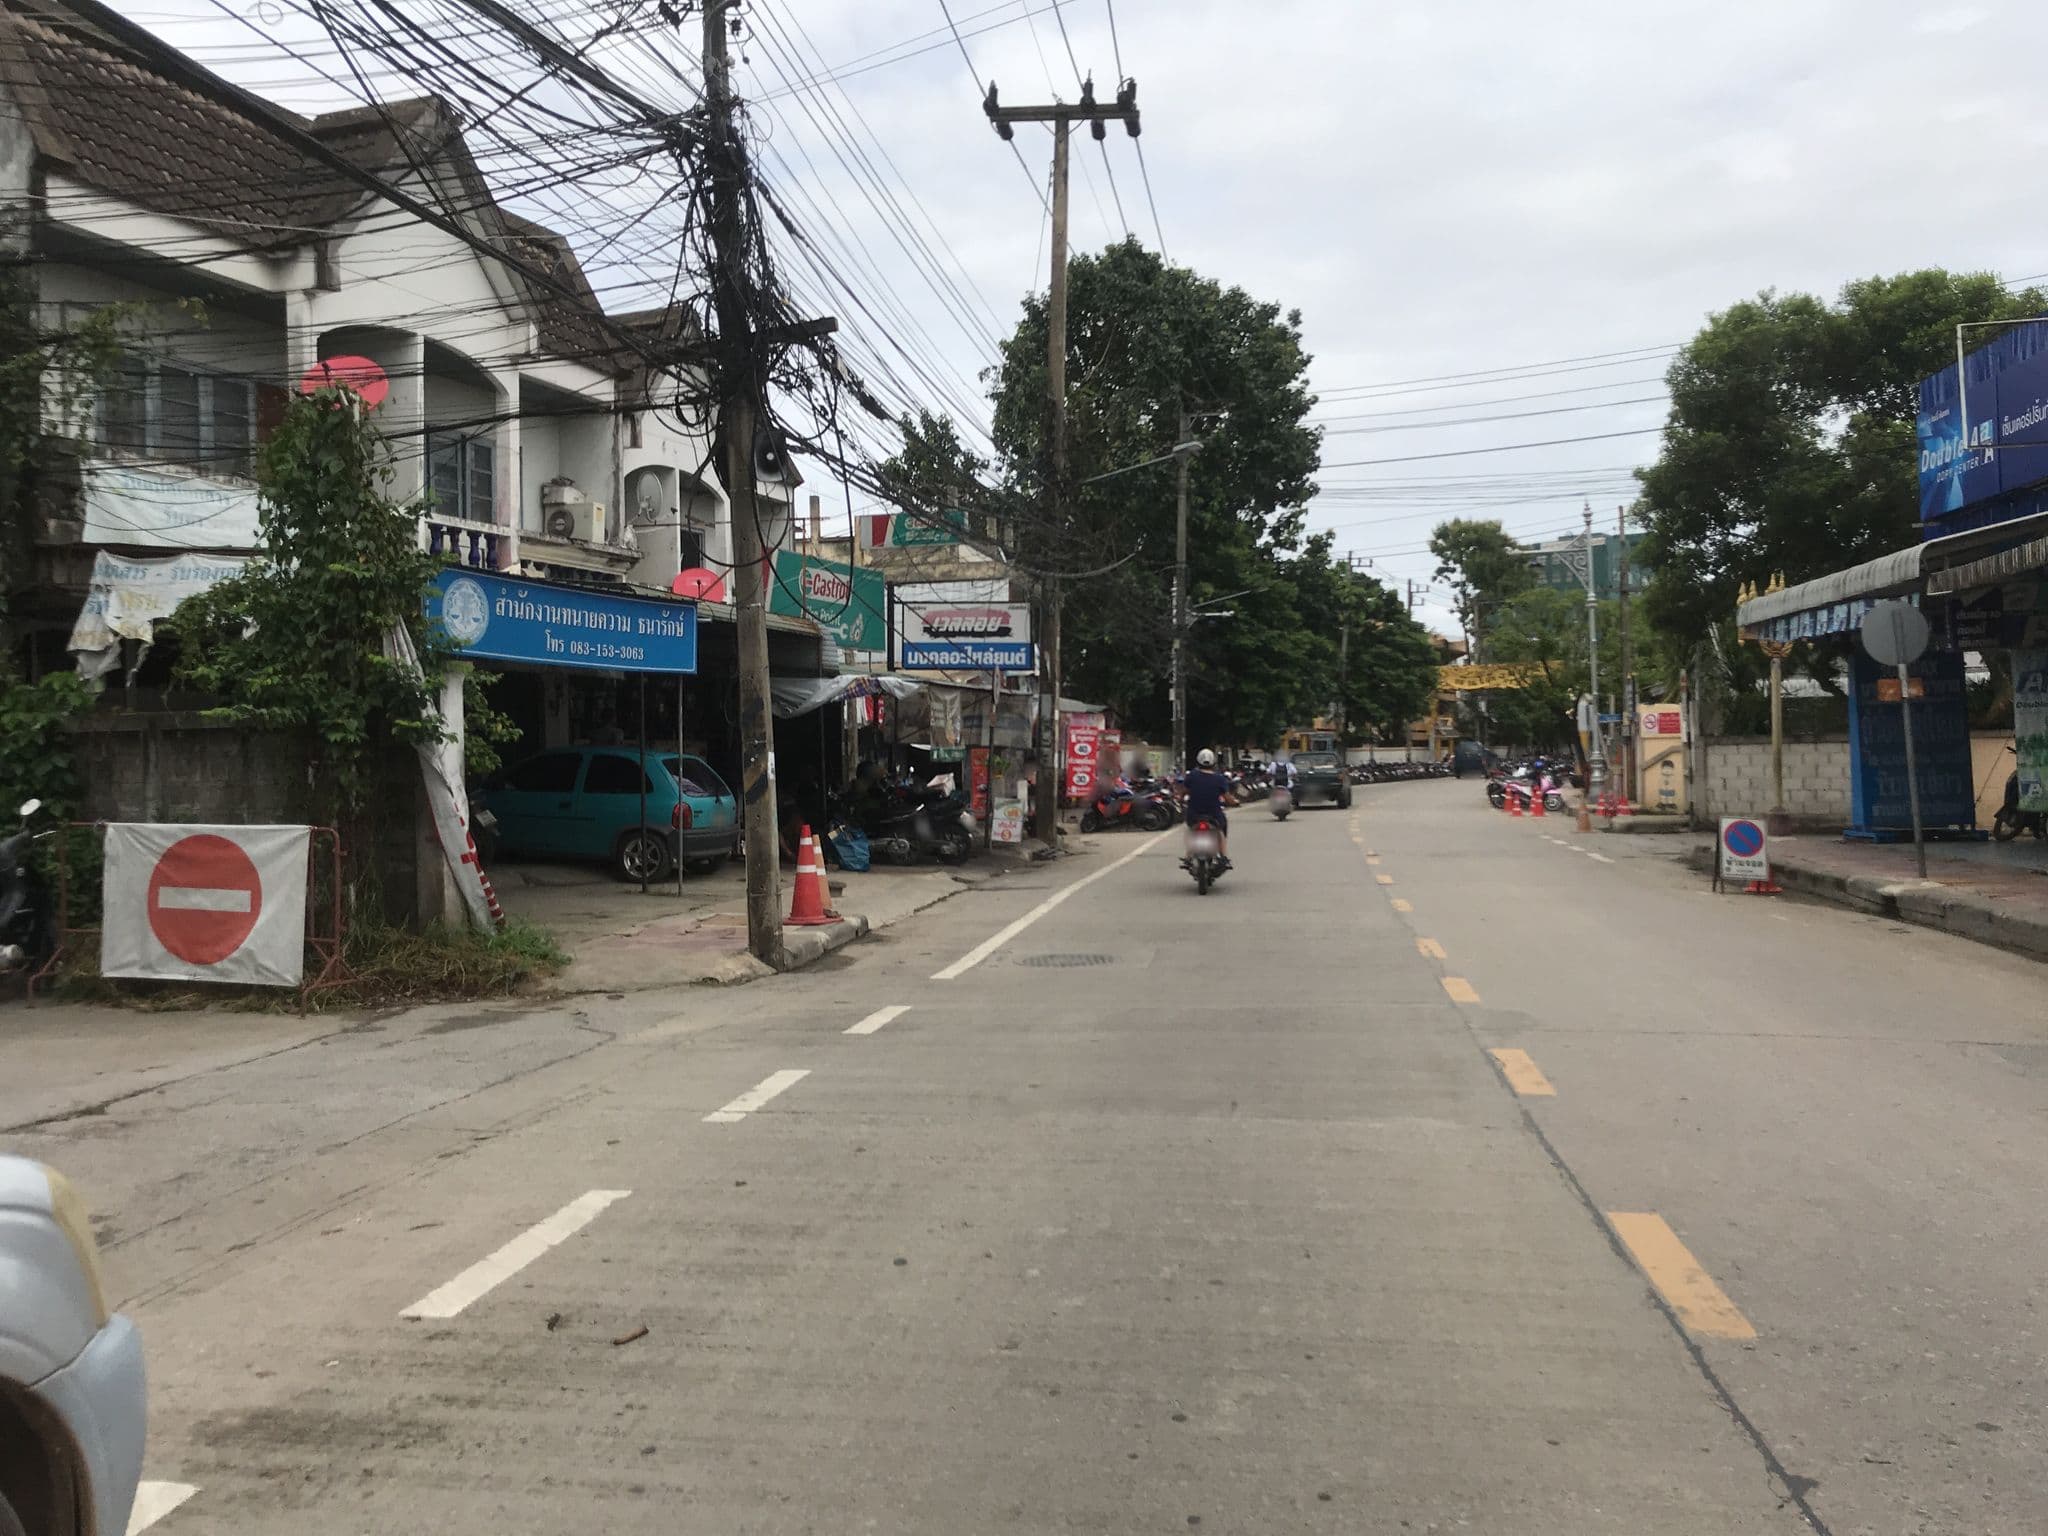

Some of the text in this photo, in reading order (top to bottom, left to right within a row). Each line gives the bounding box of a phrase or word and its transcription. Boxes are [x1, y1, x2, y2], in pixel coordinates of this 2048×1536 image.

[813, 573, 849, 600] Castrol
[495, 587, 631, 633] สำนักงานทนายความ
[637, 609, 685, 638] ธนารักษ์
[545, 629, 644, 661] โทร 083-153-3063
[908, 646, 1026, 665] มงคลอะไหล่ยนต์
